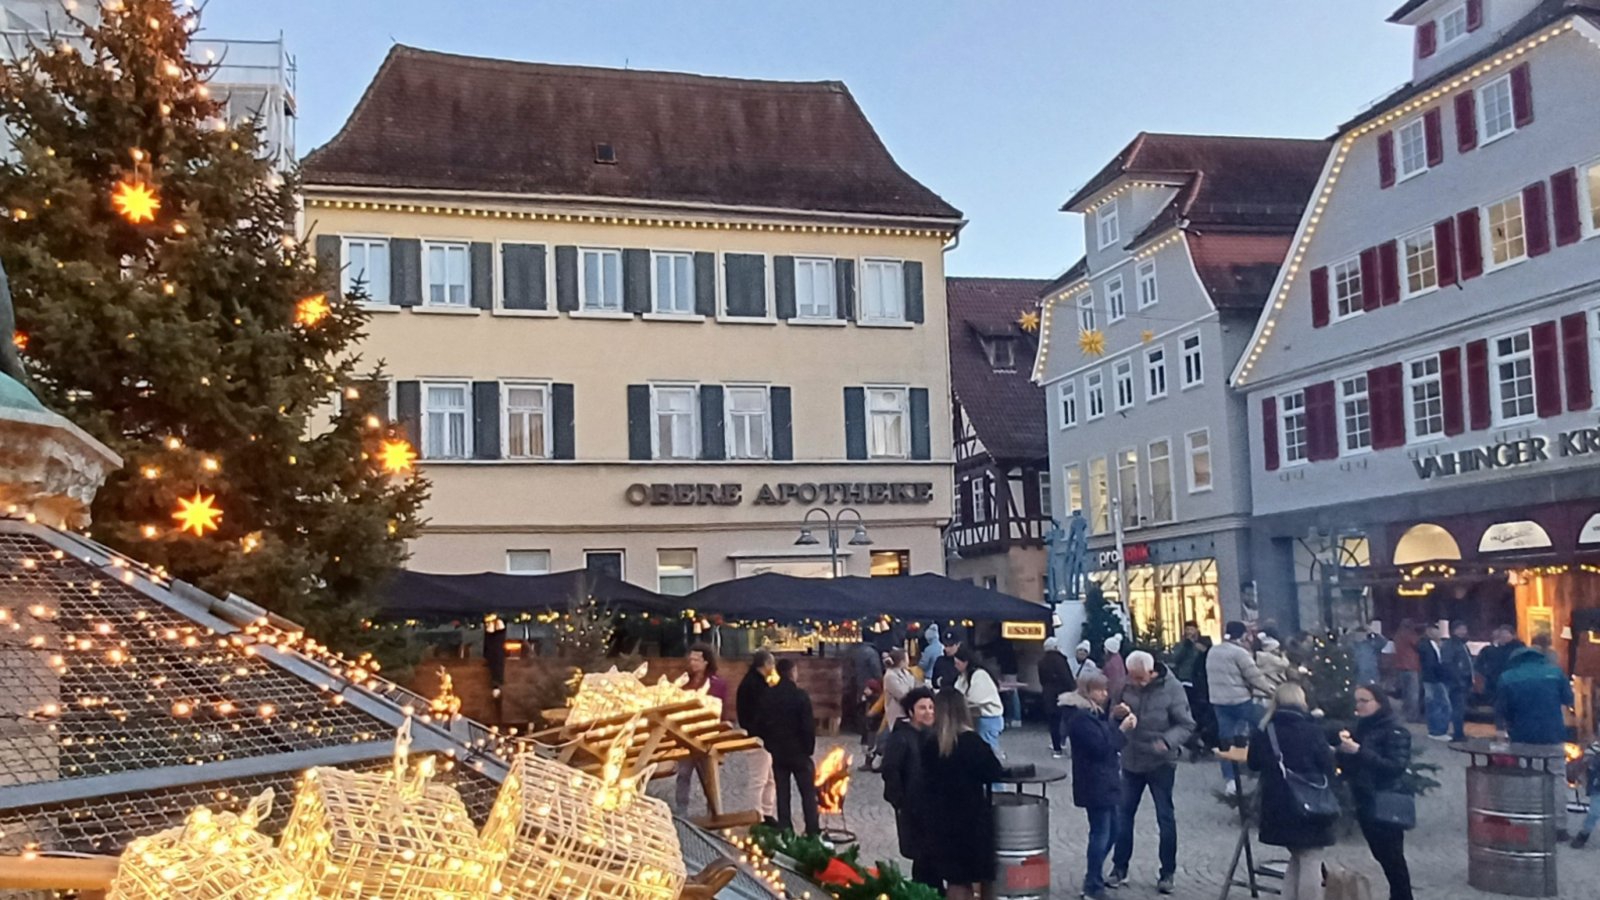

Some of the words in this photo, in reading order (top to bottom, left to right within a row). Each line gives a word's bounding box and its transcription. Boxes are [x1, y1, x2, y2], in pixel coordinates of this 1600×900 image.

[1412, 436, 1549, 479] VAIHINGER
[1559, 426, 1600, 457] KR
[625, 483, 742, 506] OBERE
[753, 482, 934, 505] APOTHEKE
